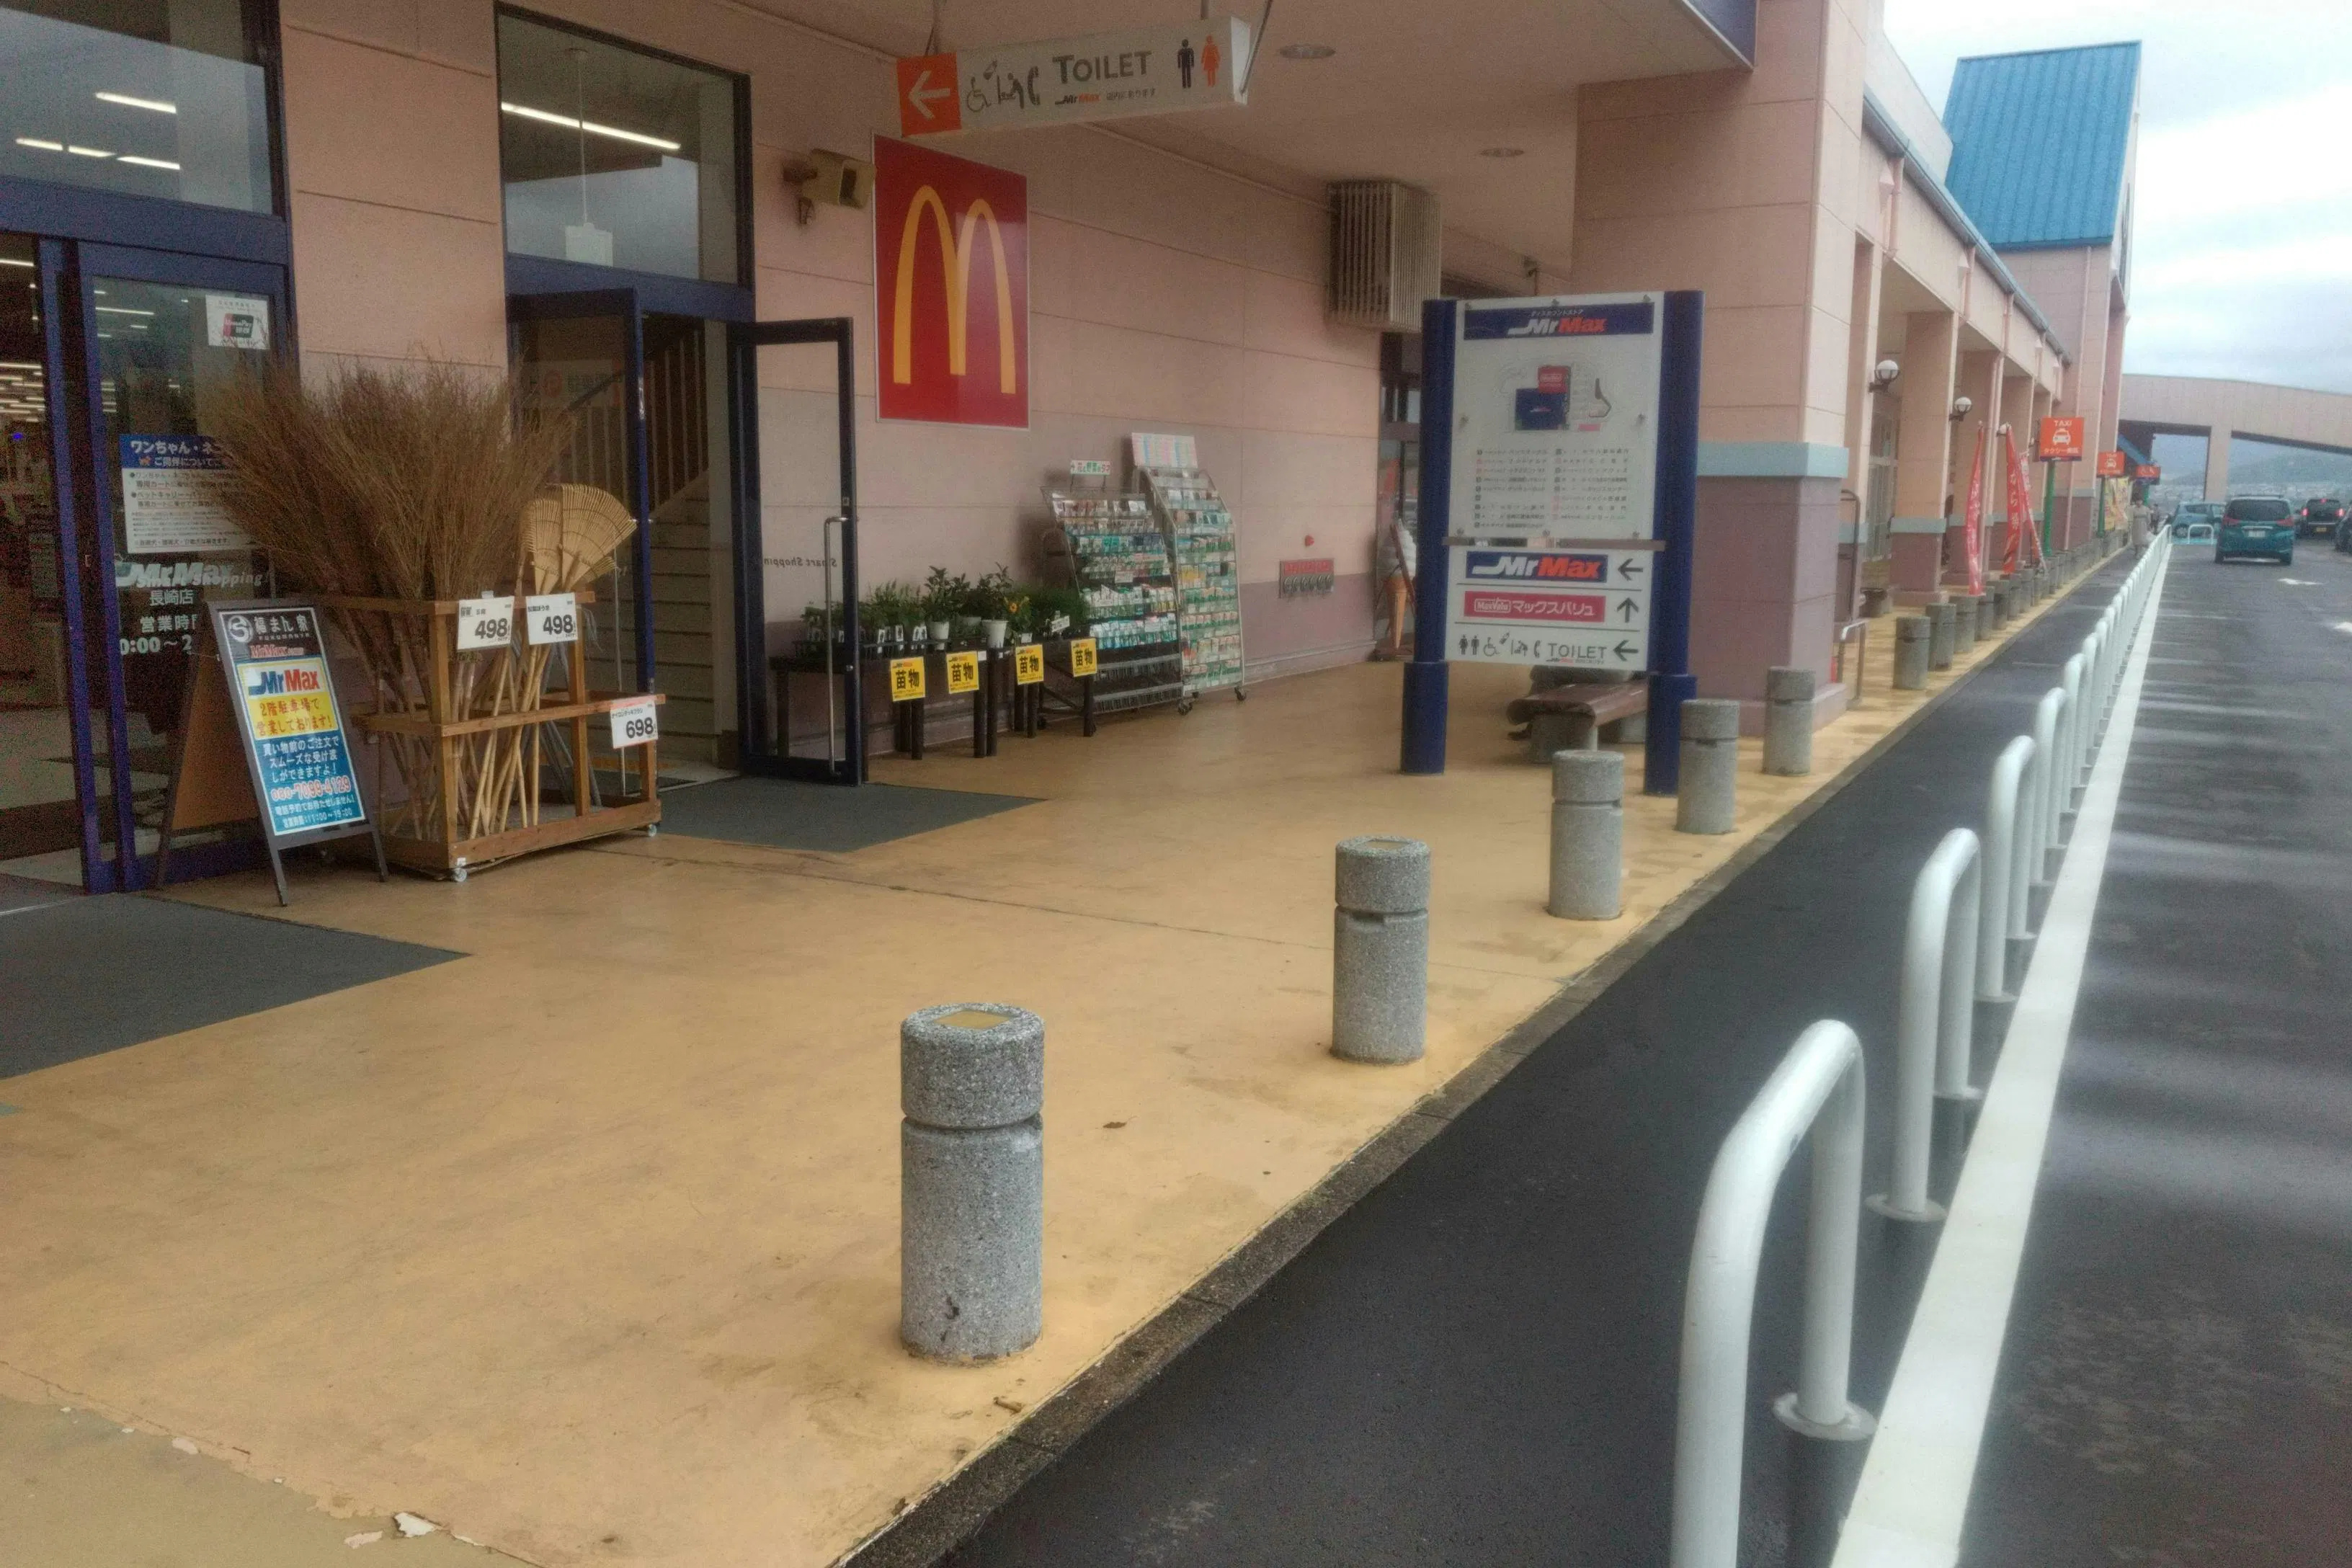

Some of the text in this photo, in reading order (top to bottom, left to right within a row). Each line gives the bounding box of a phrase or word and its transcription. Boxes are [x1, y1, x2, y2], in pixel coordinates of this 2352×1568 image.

[1053, 50, 1152, 85] TOILET
[1507, 317, 1608, 336] MrMax
[1472, 556, 1603, 579] MrMax
[149, 589, 195, 606] 長崎店
[1513, 600, 1595, 616] マックスバリュ
[475, 618, 508, 639] 498
[543, 614, 574, 635] 498
[1075, 647, 1093, 666] 苗物
[1548, 642, 1608, 659] TOILET
[951, 662, 974, 682] 苗物
[1019, 654, 1039, 674] 苗物
[248, 668, 321, 696] MrMax
[896, 668, 919, 690] 苗物
[259, 697, 320, 717] 2階駐車場で
[625, 716, 654, 739] 698
